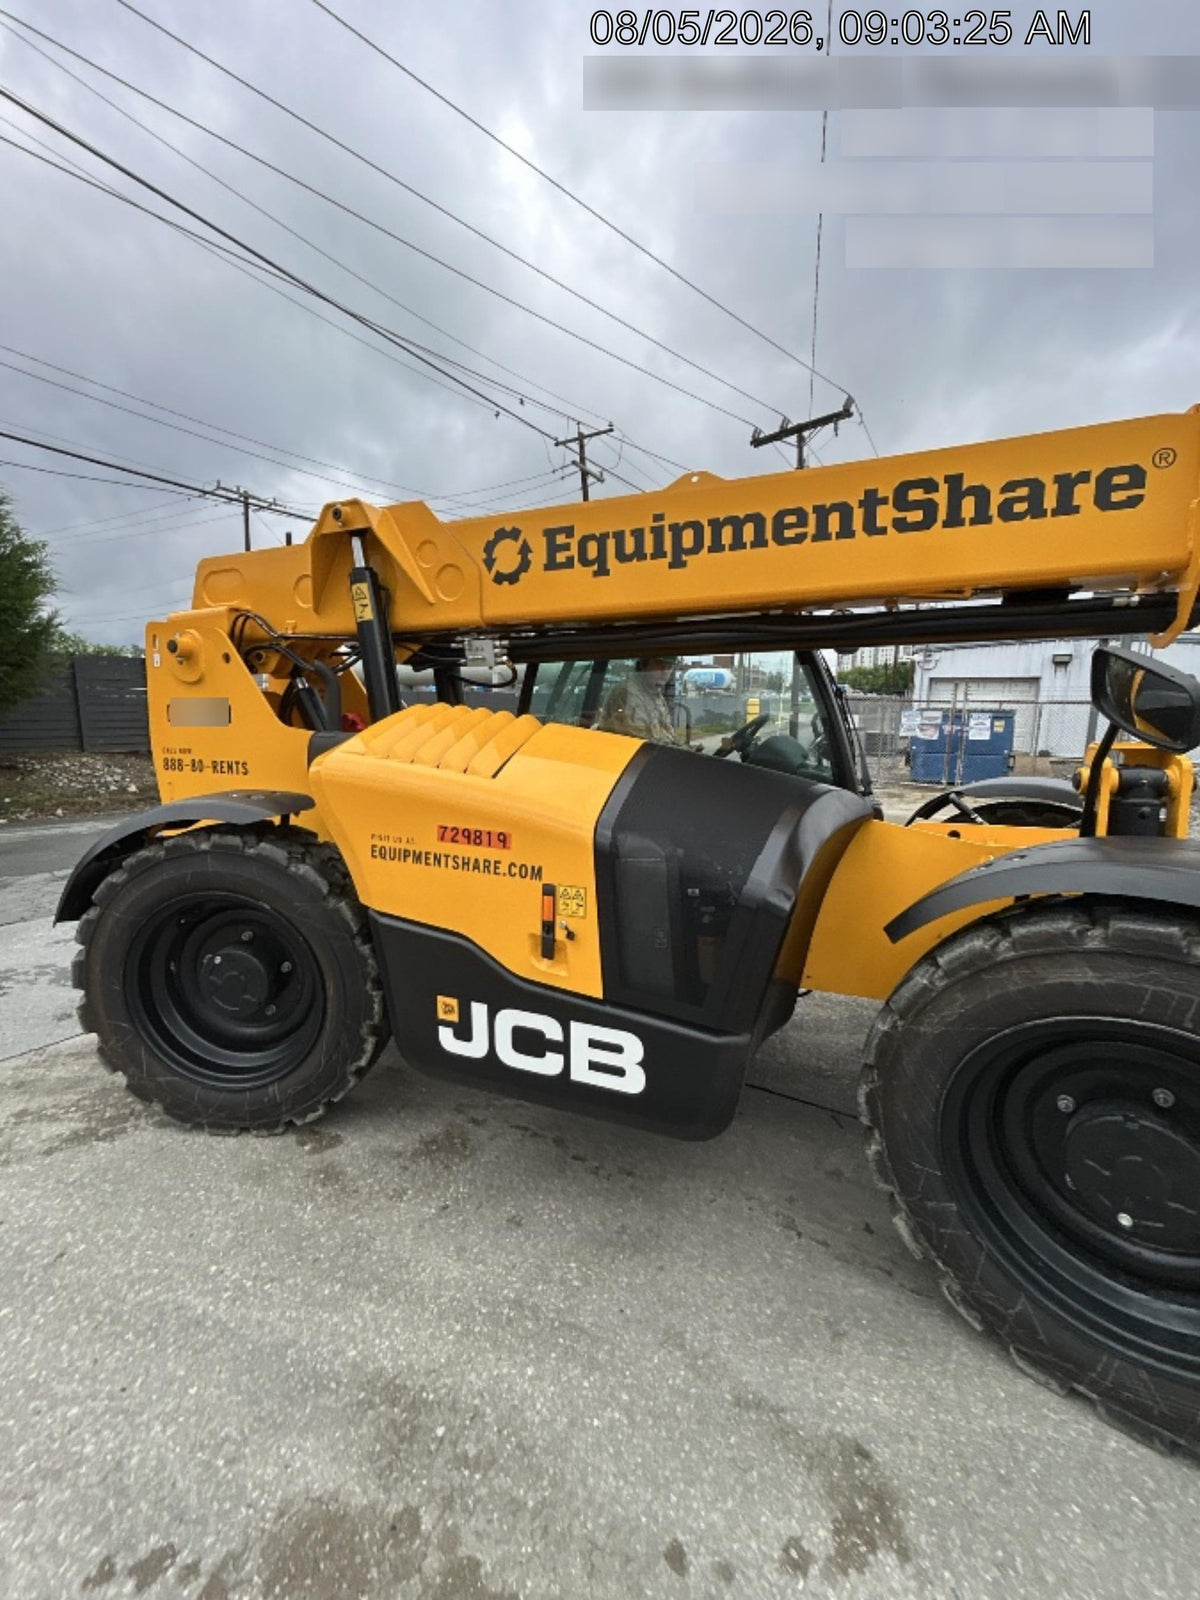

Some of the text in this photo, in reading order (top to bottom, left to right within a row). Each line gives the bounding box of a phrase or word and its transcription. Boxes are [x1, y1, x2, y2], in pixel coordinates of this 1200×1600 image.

[162, 757, 249, 776] 888-80-RENTS
[439, 825, 508, 849] 729819
[371, 844, 542, 881] EQUIPMENTSHARE.COM
[438, 1001, 646, 1094] JCB
